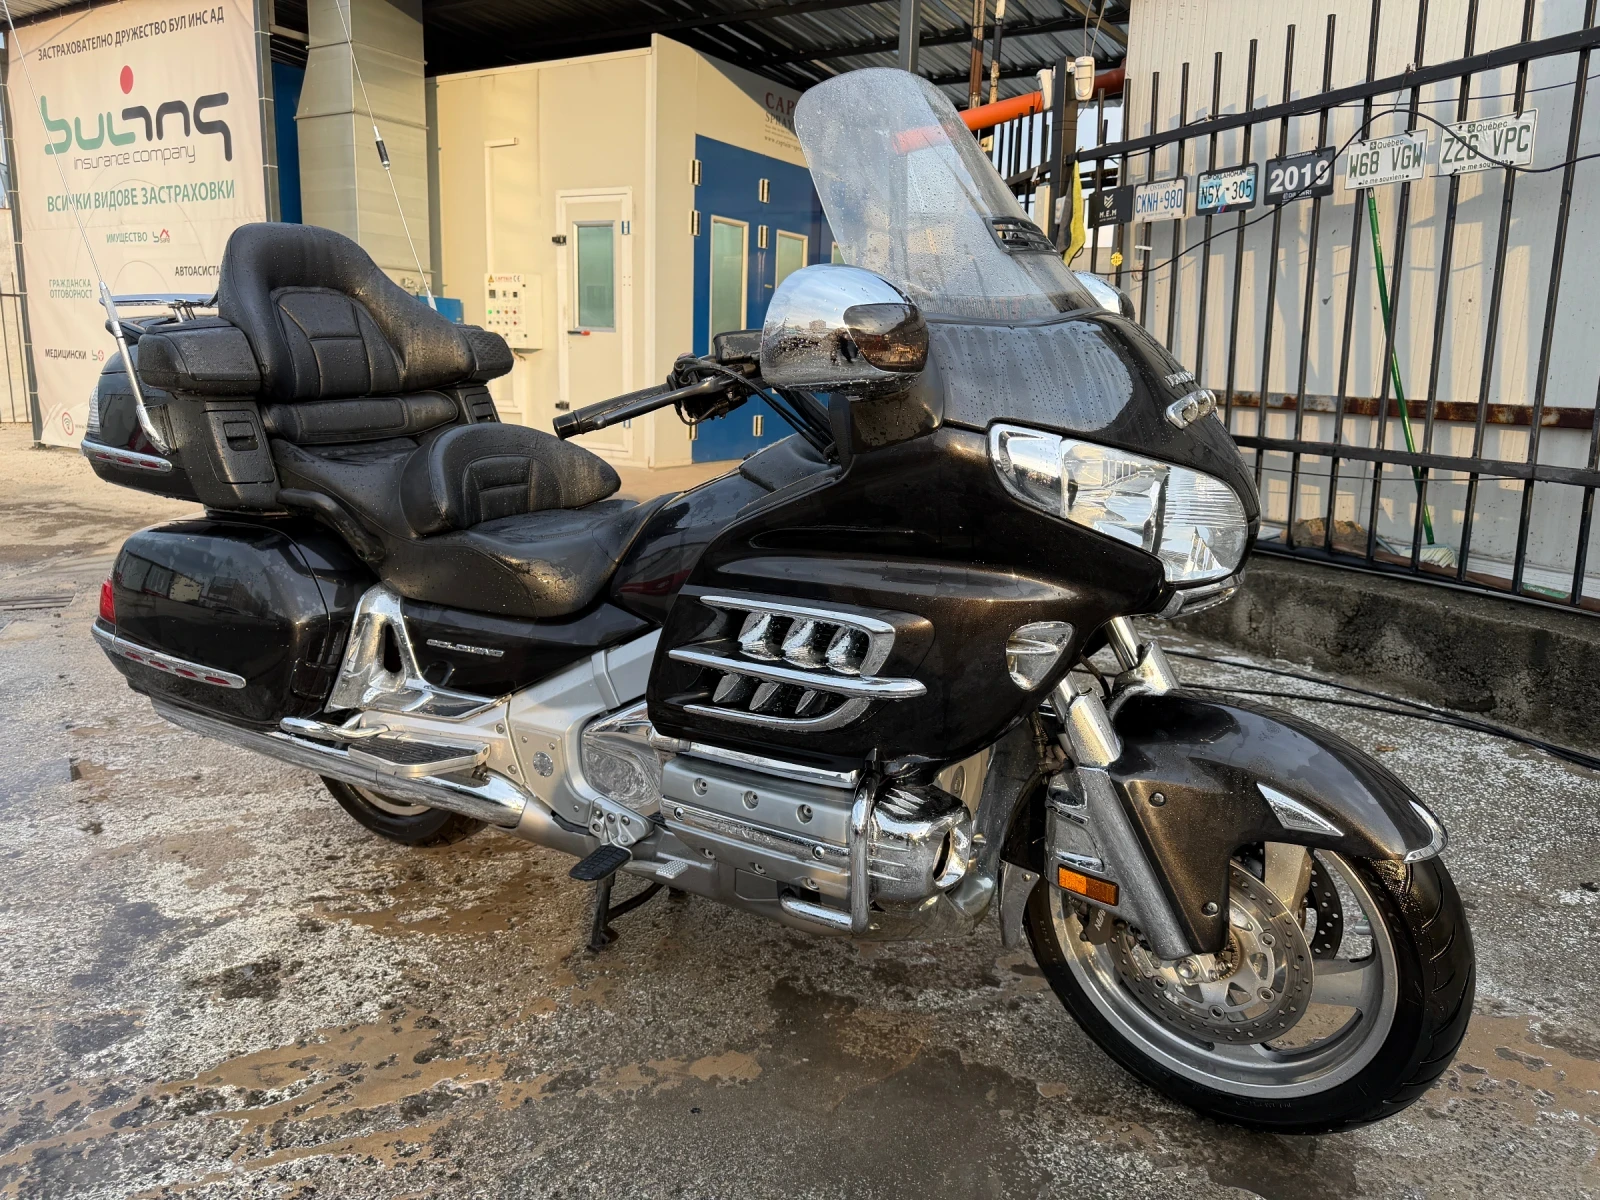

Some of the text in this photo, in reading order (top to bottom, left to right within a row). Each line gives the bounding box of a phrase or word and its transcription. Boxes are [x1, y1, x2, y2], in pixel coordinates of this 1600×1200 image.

[38, 6, 224, 61] ЗАСТРАХОВАТЕЛНО ДРУЖЕСТВО БУЛ ИНС АД
[1476, 121, 1508, 133] Québec
[1377, 139, 1404, 149] Québec
[1442, 124, 1530, 163] Z26 VPC
[74, 145, 195, 170] insurance company
[1349, 142, 1423, 178] W68 VGW
[1467, 162, 1478, 170] me
[1479, 159, 1509, 168] souvns
[1269, 160, 1330, 193] 2019
[47, 180, 235, 212] ВСИЧКИ ВИДОВЕ ЗАСТРАХОВКИ
[106, 232, 147, 243] ИМУЩЕСТВО
[49, 279, 91, 288] ГРАЖДАНСКА
[50, 290, 92, 298] ОТГОВОРНОСТ
[45, 349, 87, 360] МЕДИЦИНСКИ
